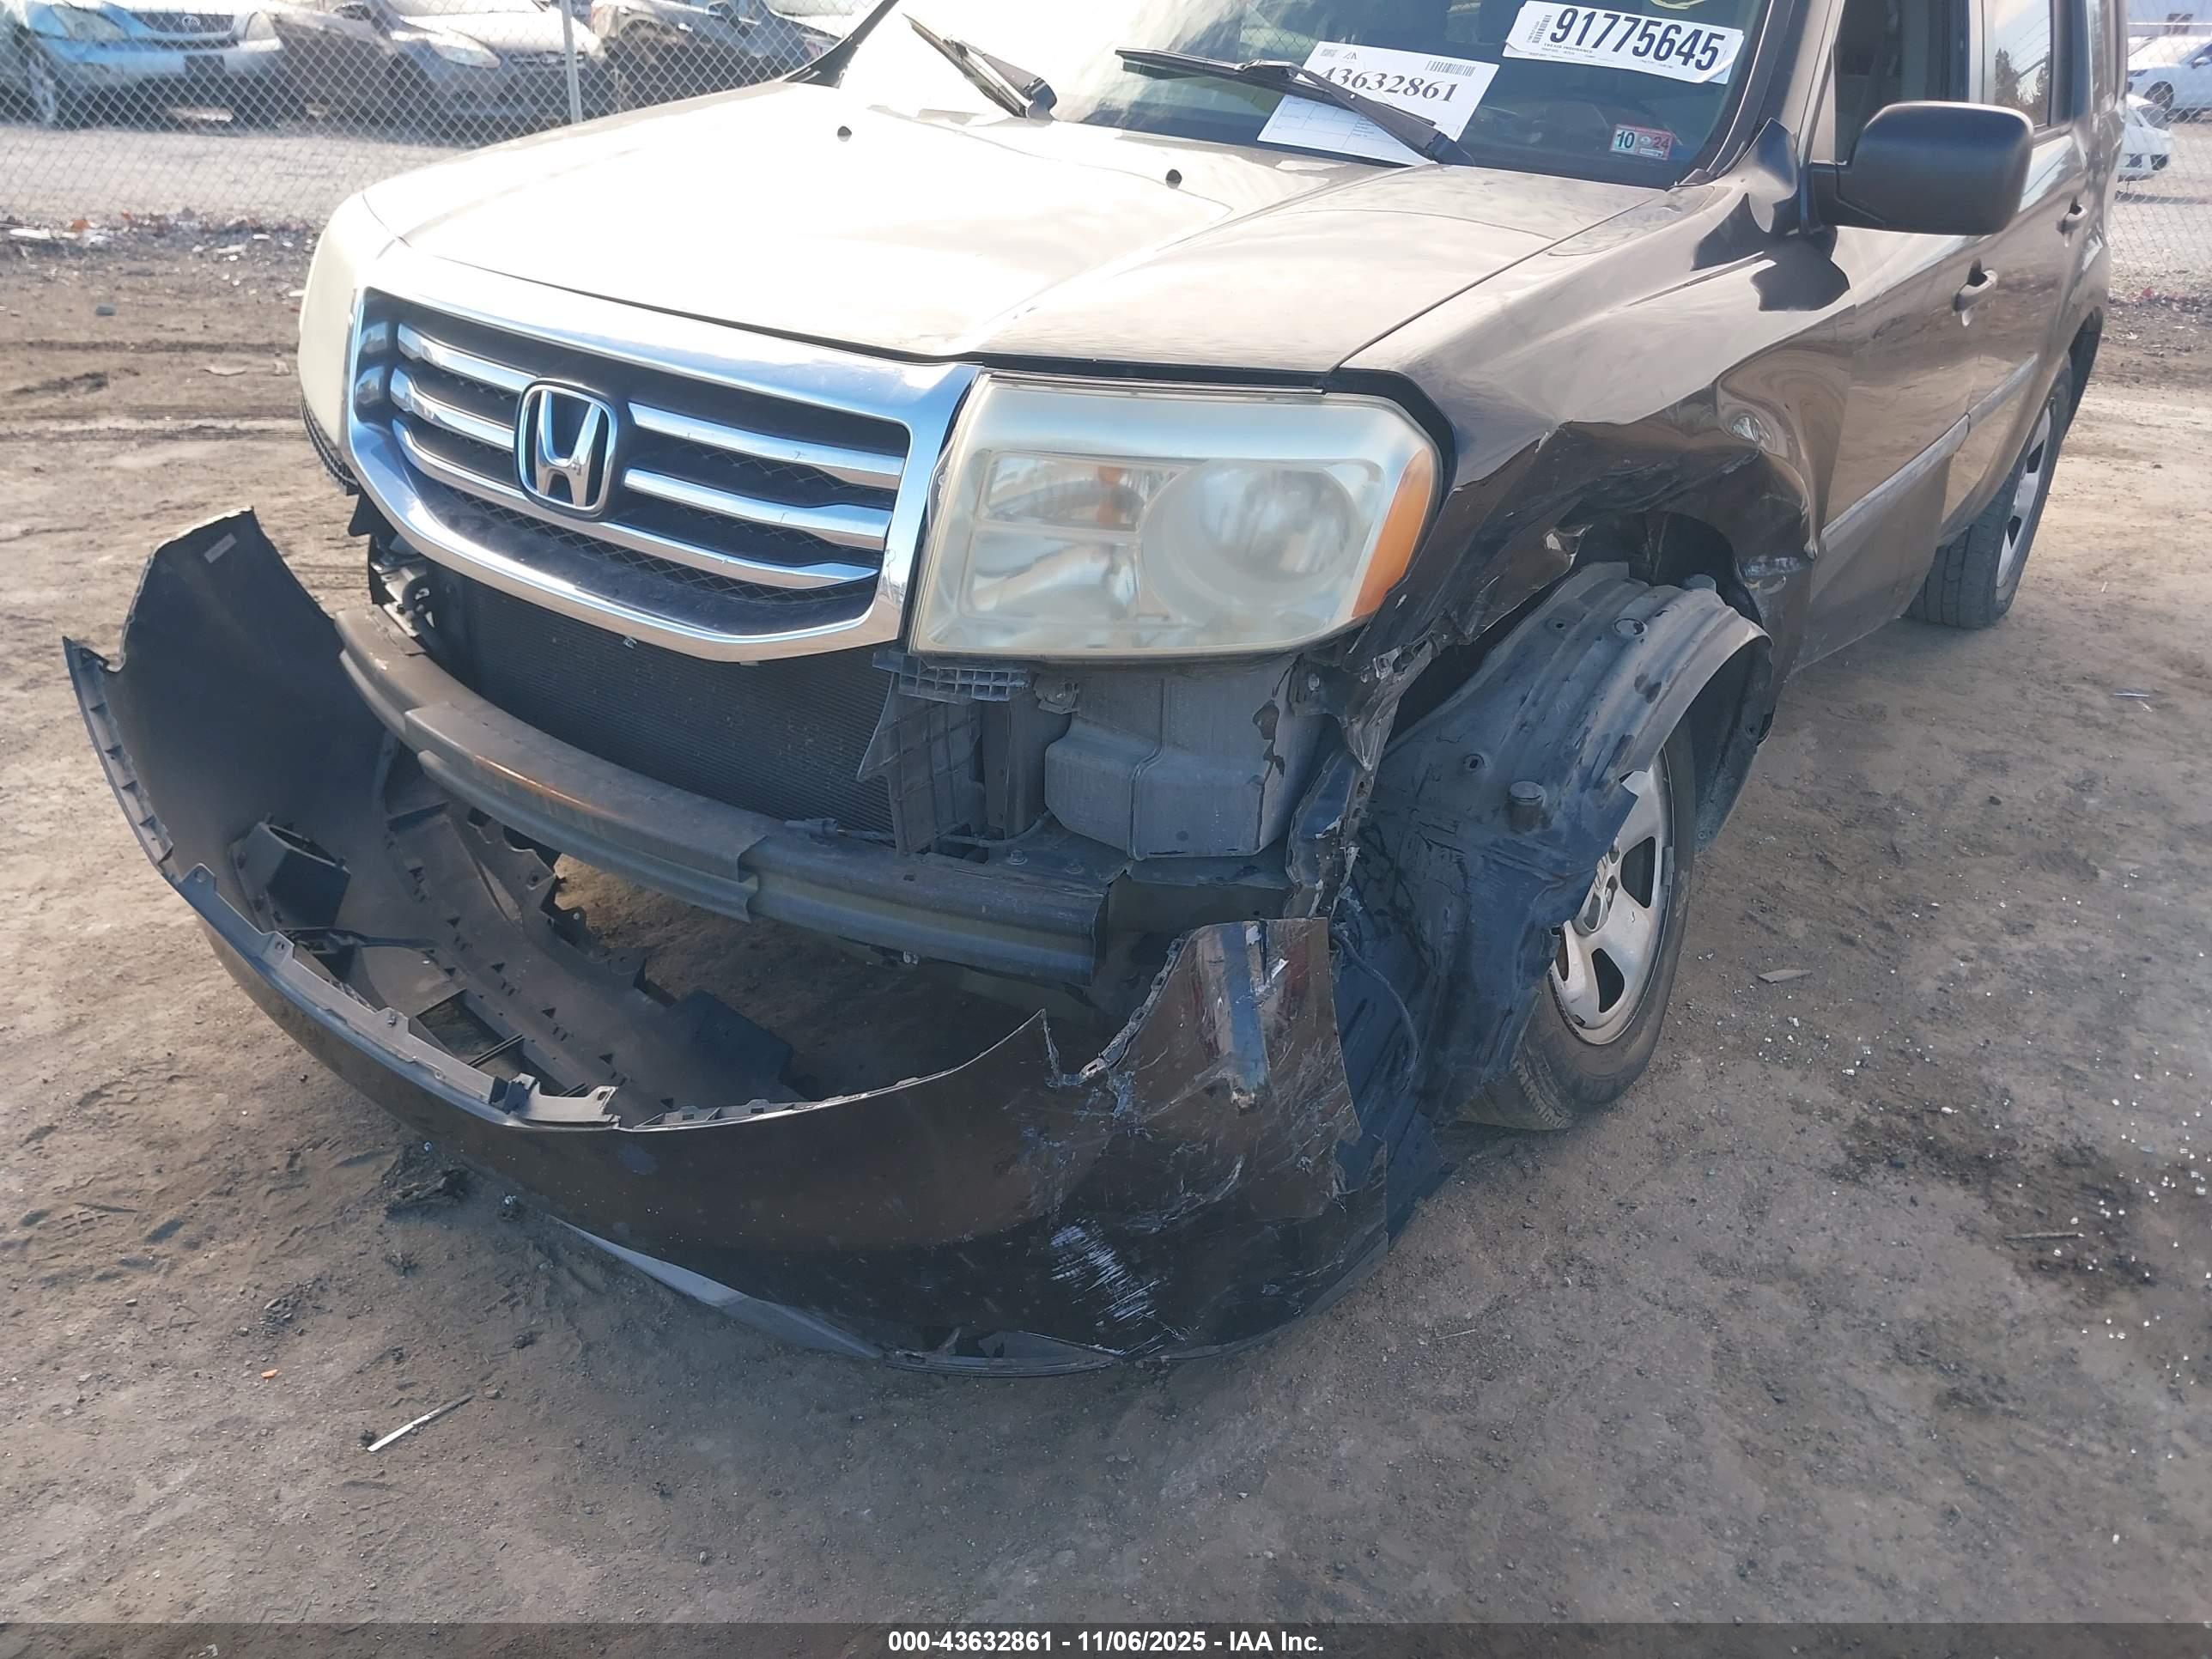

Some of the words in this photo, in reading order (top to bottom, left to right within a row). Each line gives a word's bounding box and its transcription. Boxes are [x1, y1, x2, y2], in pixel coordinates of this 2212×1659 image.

[1550, 8, 1725, 71] 91775645
[1319, 66, 1458, 102] 43632861
[1617, 131, 1635, 149] 10
